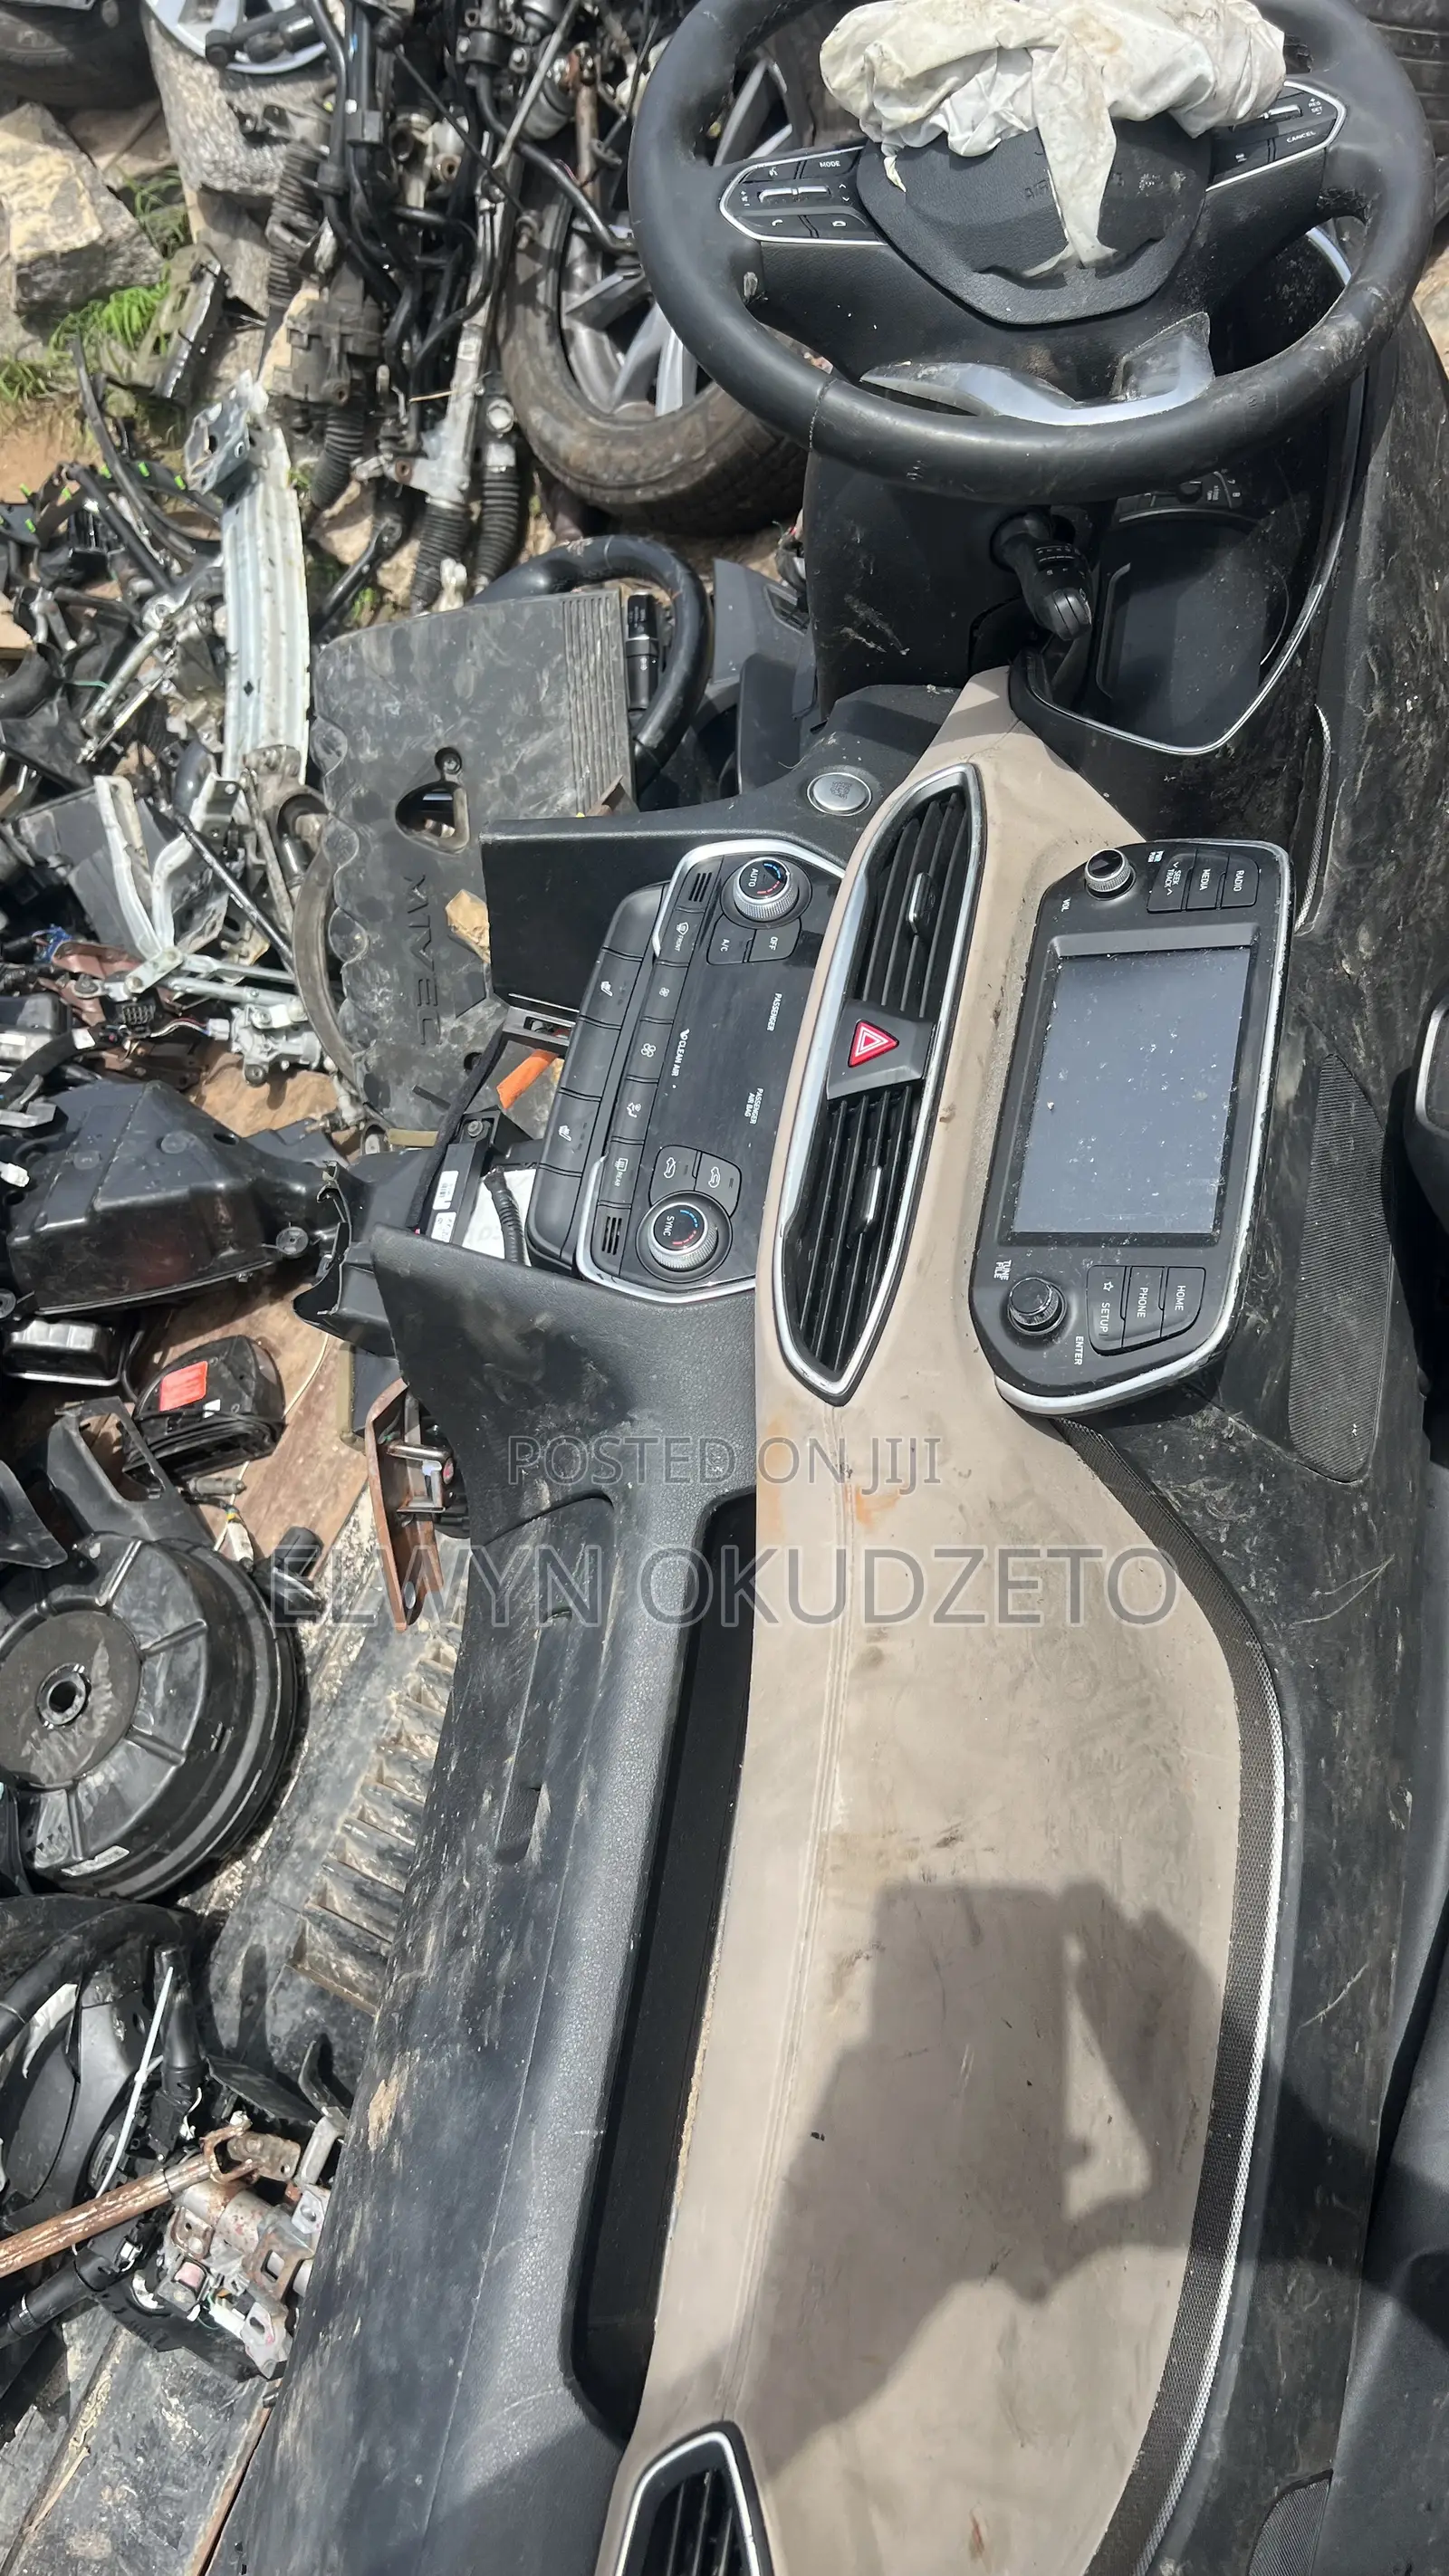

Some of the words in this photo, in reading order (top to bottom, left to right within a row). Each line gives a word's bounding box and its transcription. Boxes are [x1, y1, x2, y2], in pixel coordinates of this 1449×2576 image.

[1286, 131, 1316, 142] CANCEL
[819, 160, 840, 168] MODE
[748, 867, 759, 887] AUTO
[1164, 869, 1175, 887] TRACK
[1172, 869, 1182, 886] SEEK
[1199, 868, 1212, 891] MEDIA
[1233, 869, 1245, 892] RADIO
[1060, 896, 1071, 913] VOL
[675, 934, 684, 952] FRONT
[720, 938, 730, 952] A/C
[769, 936, 779, 951] OFF
[767, 992, 782, 1031] PASSENGER
[675, 1040, 686, 1064] CLEAN
[671, 1064, 680, 1077] AIR
[747, 1092, 756, 1104] AIR
[749, 1087, 764, 1125] PASSENGER
[744, 1104, 753, 1117] BAG
[615, 1171, 623, 1187] REAR
[663, 1215, 675, 1237] SYNC
[993, 1261, 1003, 1278] FILE
[1001, 1259, 1012, 1280] TUNE
[1137, 1287, 1149, 1318] PHONE
[1175, 1285, 1186, 1311] HOME
[1099, 1302, 1110, 1333] SETUP
[1073, 1336, 1085, 1365] ENTER
